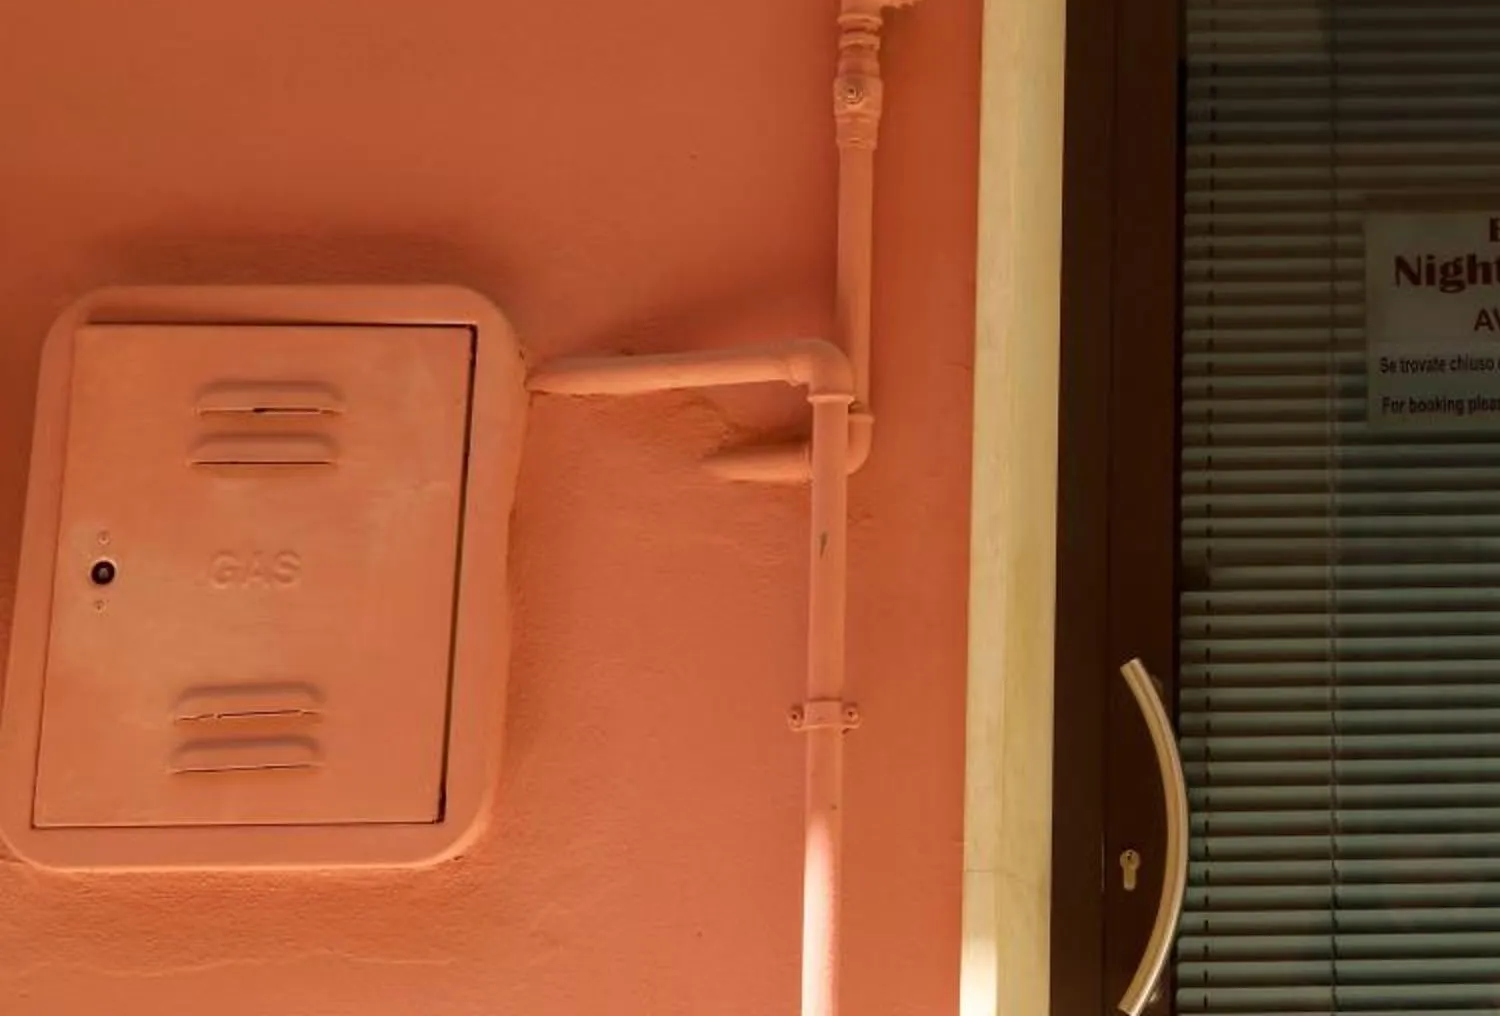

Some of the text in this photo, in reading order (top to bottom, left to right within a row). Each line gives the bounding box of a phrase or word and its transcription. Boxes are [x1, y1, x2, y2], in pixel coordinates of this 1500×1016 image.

[1380, 355, 1396, 374] Se
[1399, 355, 1446, 374] trovate
[1450, 352, 1494, 372] chiuso
[1382, 396, 1405, 415] For
[1409, 395, 1465, 417] booking
[209, 550, 301, 587] GAS
